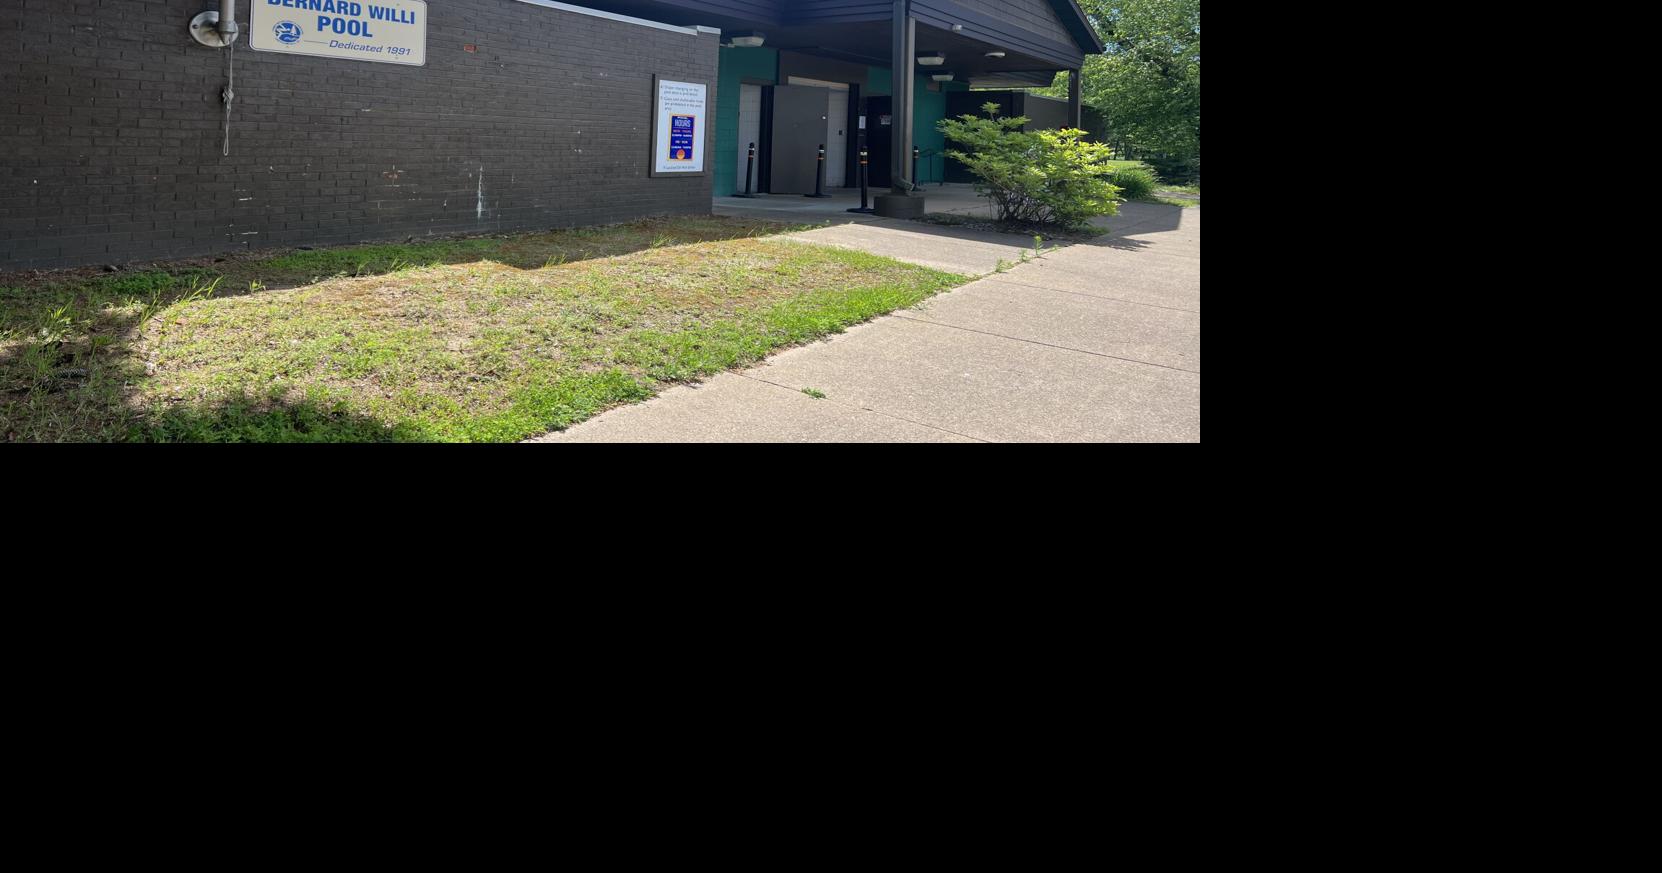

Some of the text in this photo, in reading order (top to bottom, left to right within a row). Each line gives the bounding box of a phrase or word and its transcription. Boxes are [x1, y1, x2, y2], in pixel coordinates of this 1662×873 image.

[368, 5, 415, 24] WILLI
[317, 15, 373, 38] POOL
[329, 39, 411, 56] Dedicated 1991
[674, 119, 691, 128] HOURS
